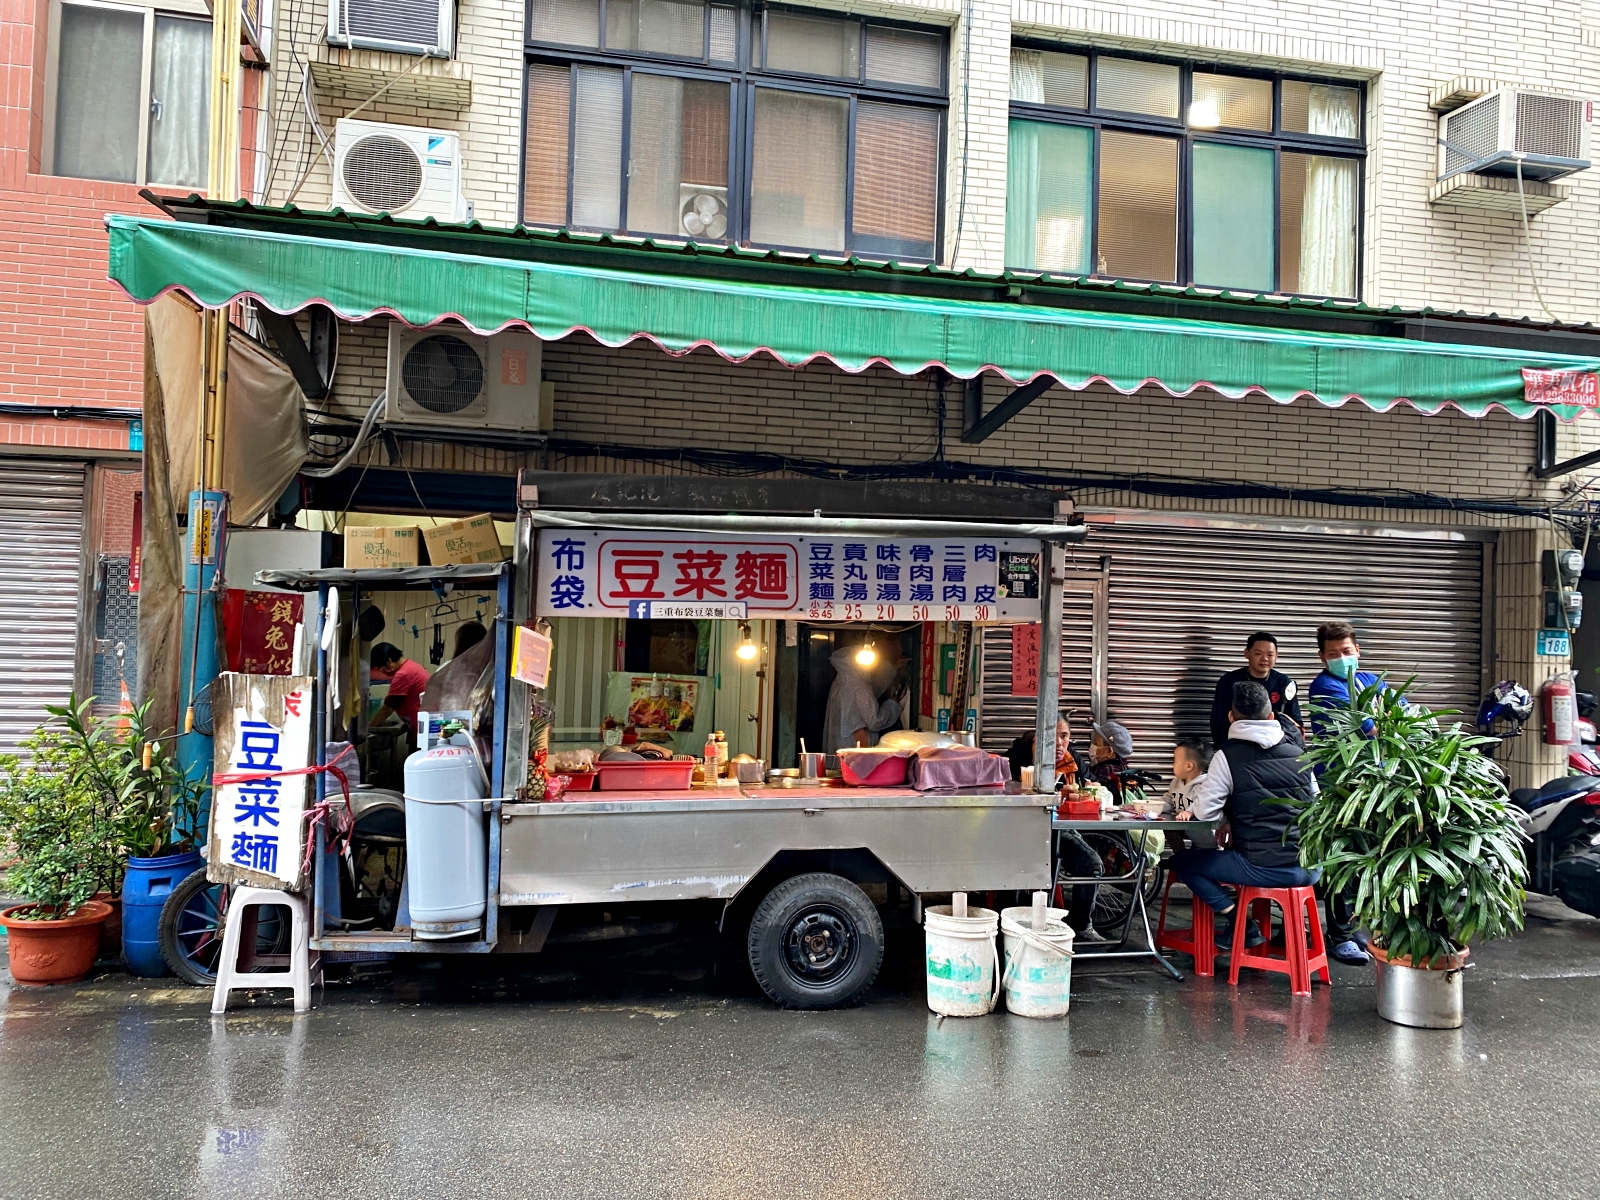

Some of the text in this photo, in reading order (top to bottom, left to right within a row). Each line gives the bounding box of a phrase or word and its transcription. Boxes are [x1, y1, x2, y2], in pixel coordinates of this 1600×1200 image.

[1526, 372, 1596, 394] 華美帆布
[364, 542, 385, 556] 優活
[445, 536, 467, 552] 優活
[1009, 556, 1029, 564] Uber
[550, 537, 586, 609] 布袋
[608, 549, 789, 601] 豆菜麵
[809, 543, 835, 600] 豆菜麵
[842, 543, 868, 601] 貢丸湯
[909, 544, 934, 601] 骨肉湯
[942, 545, 967, 602] 三層肉
[810, 600, 833, 608] 小 大
[845, 604, 862, 620] 25
[876, 604, 895, 620] 20
[653, 607, 724, 618] 三重布袋豆菜麵
[809, 609, 833, 618] 35 45
[912, 604, 929, 621] 50
[945, 605, 960, 621] 50
[975, 605, 989, 621] 30
[1547, 639, 1567, 653] 188
[231, 720, 283, 874] 豆菜麵
